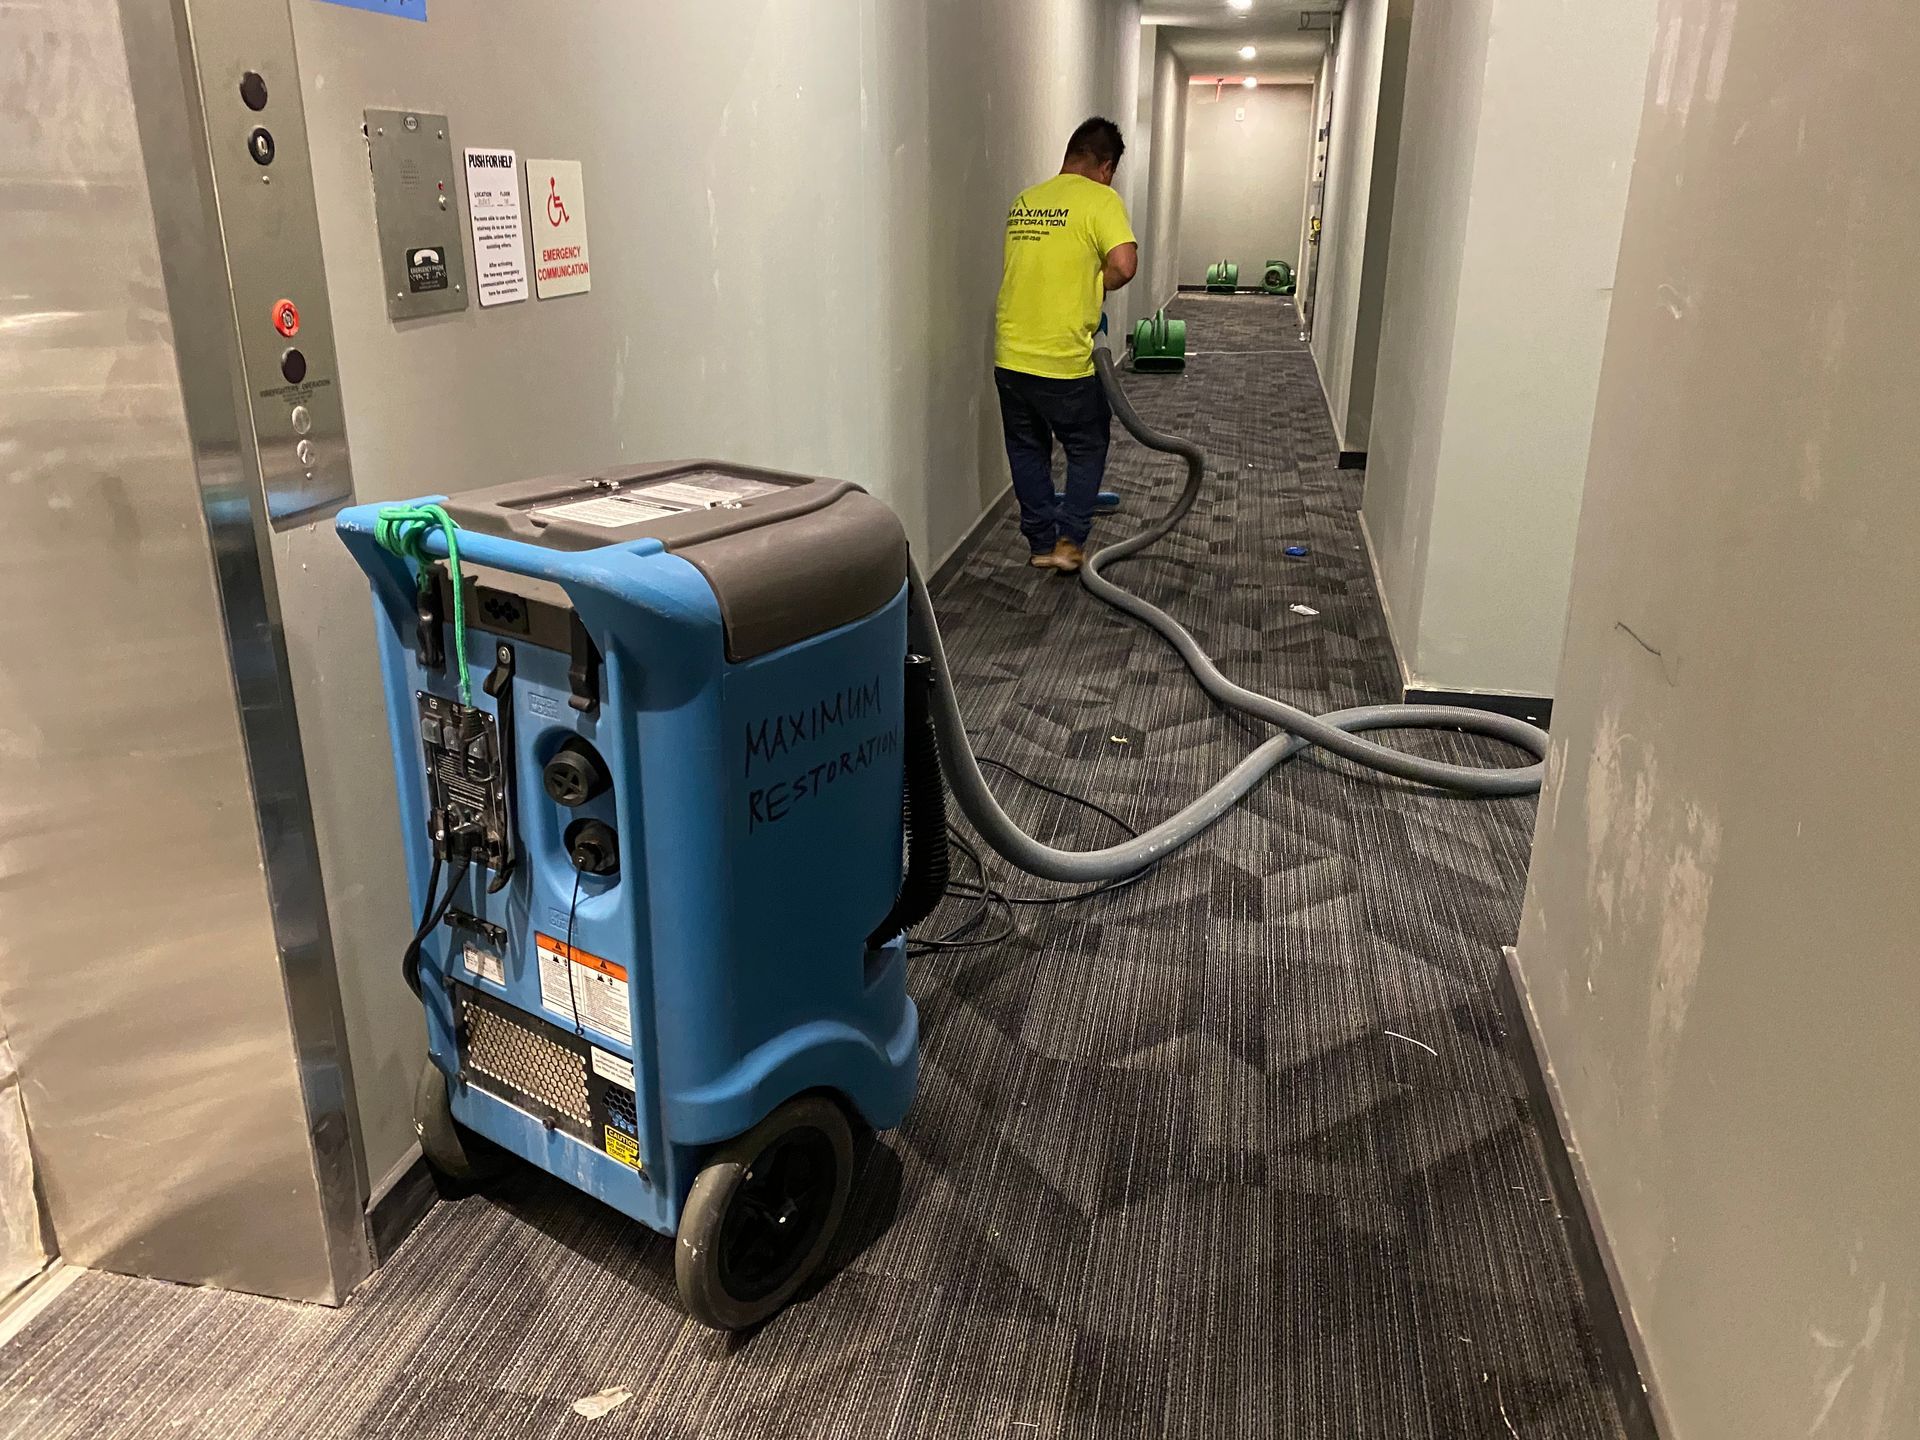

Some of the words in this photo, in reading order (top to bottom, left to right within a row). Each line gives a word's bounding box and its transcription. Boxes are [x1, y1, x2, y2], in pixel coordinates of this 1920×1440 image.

[468, 154, 485, 168] PUSH
[485, 154, 498, 168] FOR
[498, 155, 513, 168] HELP
[1009, 208, 1069, 217] MAXIMUM
[543, 246, 580, 261] EMERGENCY
[538, 262, 589, 281] COMMUNICATION
[745, 675, 881, 778] MAXIMUM
[749, 722, 898, 834] RESTORATION
[608, 1130, 638, 1150] CAUTION
